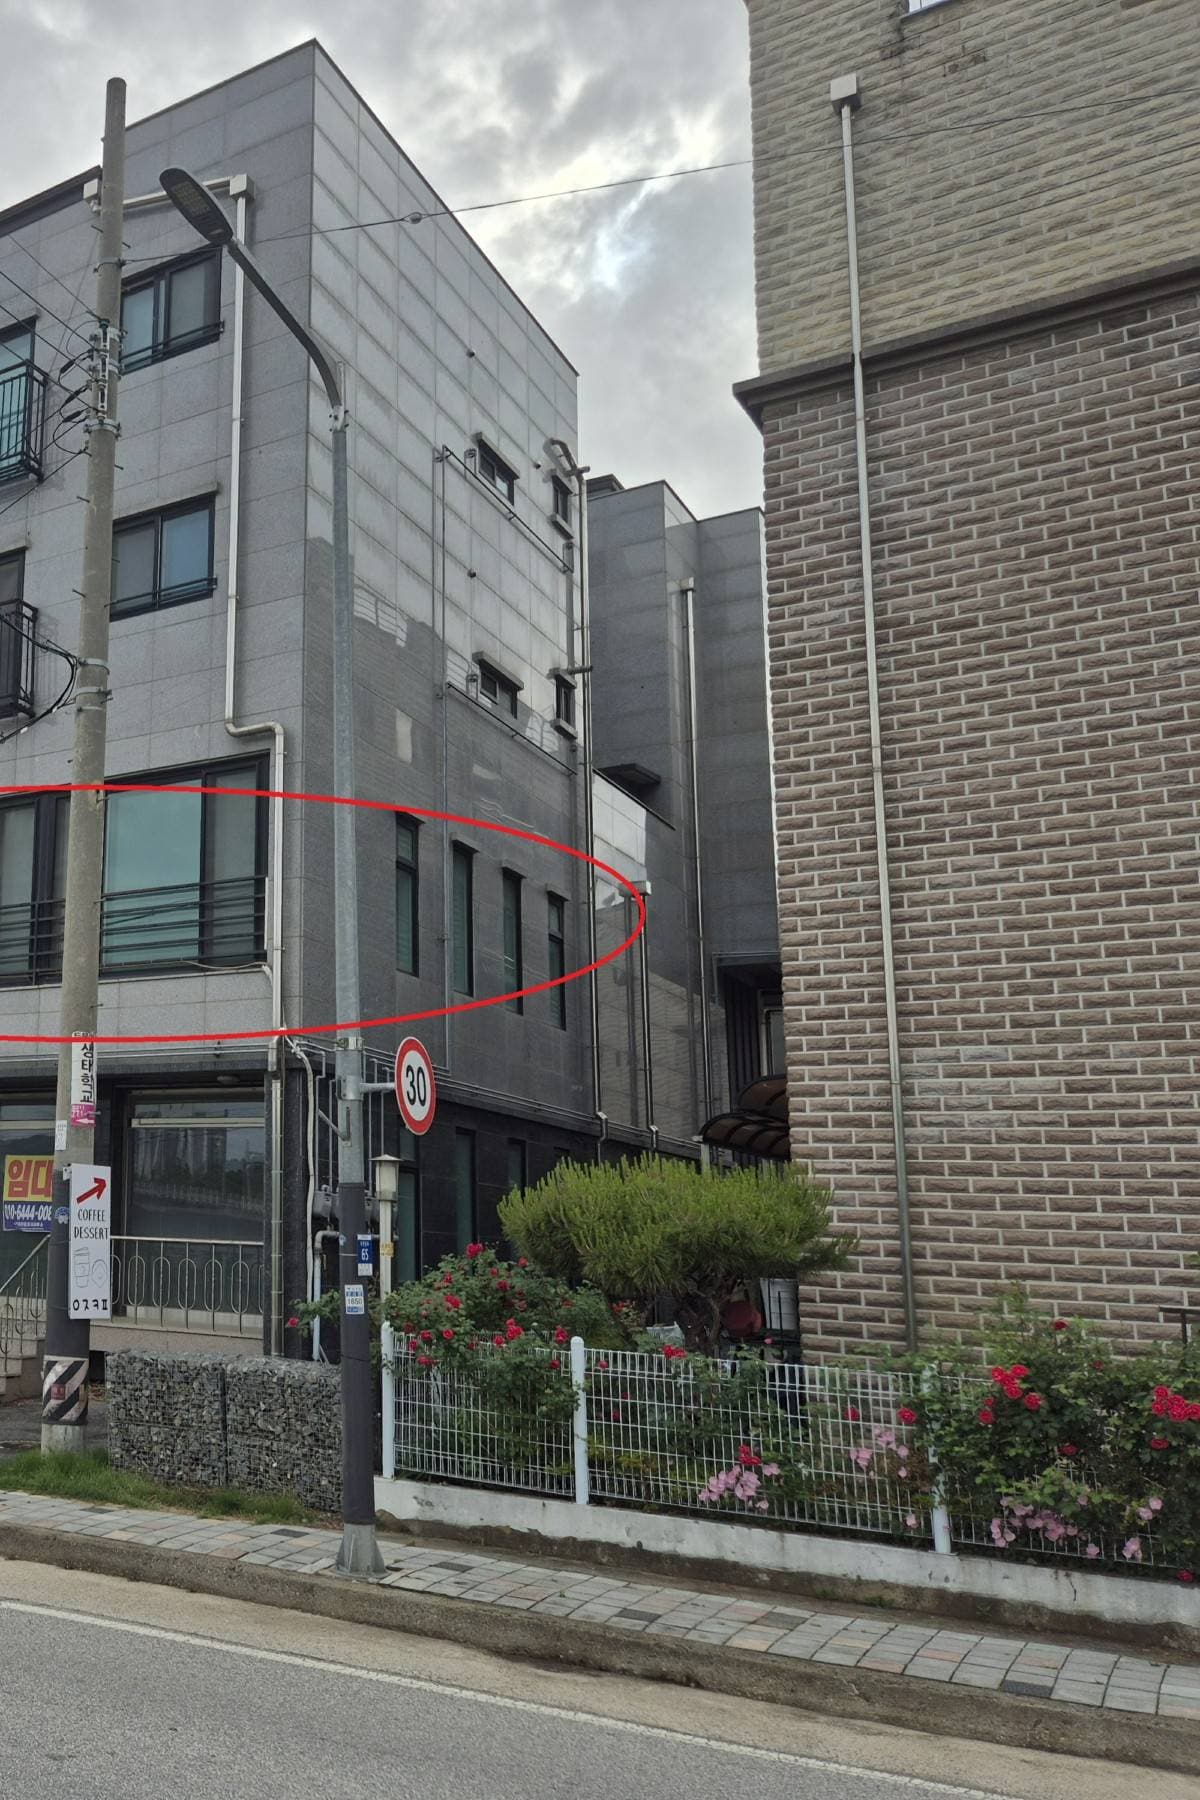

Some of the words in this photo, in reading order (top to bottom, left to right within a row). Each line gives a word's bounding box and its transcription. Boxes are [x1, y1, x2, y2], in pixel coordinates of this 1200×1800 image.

[406, 1064, 427, 1107] 30
[77, 1208, 106, 1222] COFFEE
[73, 1226, 110, 1240] DESSERT
[361, 1248, 369, 1260] 65
